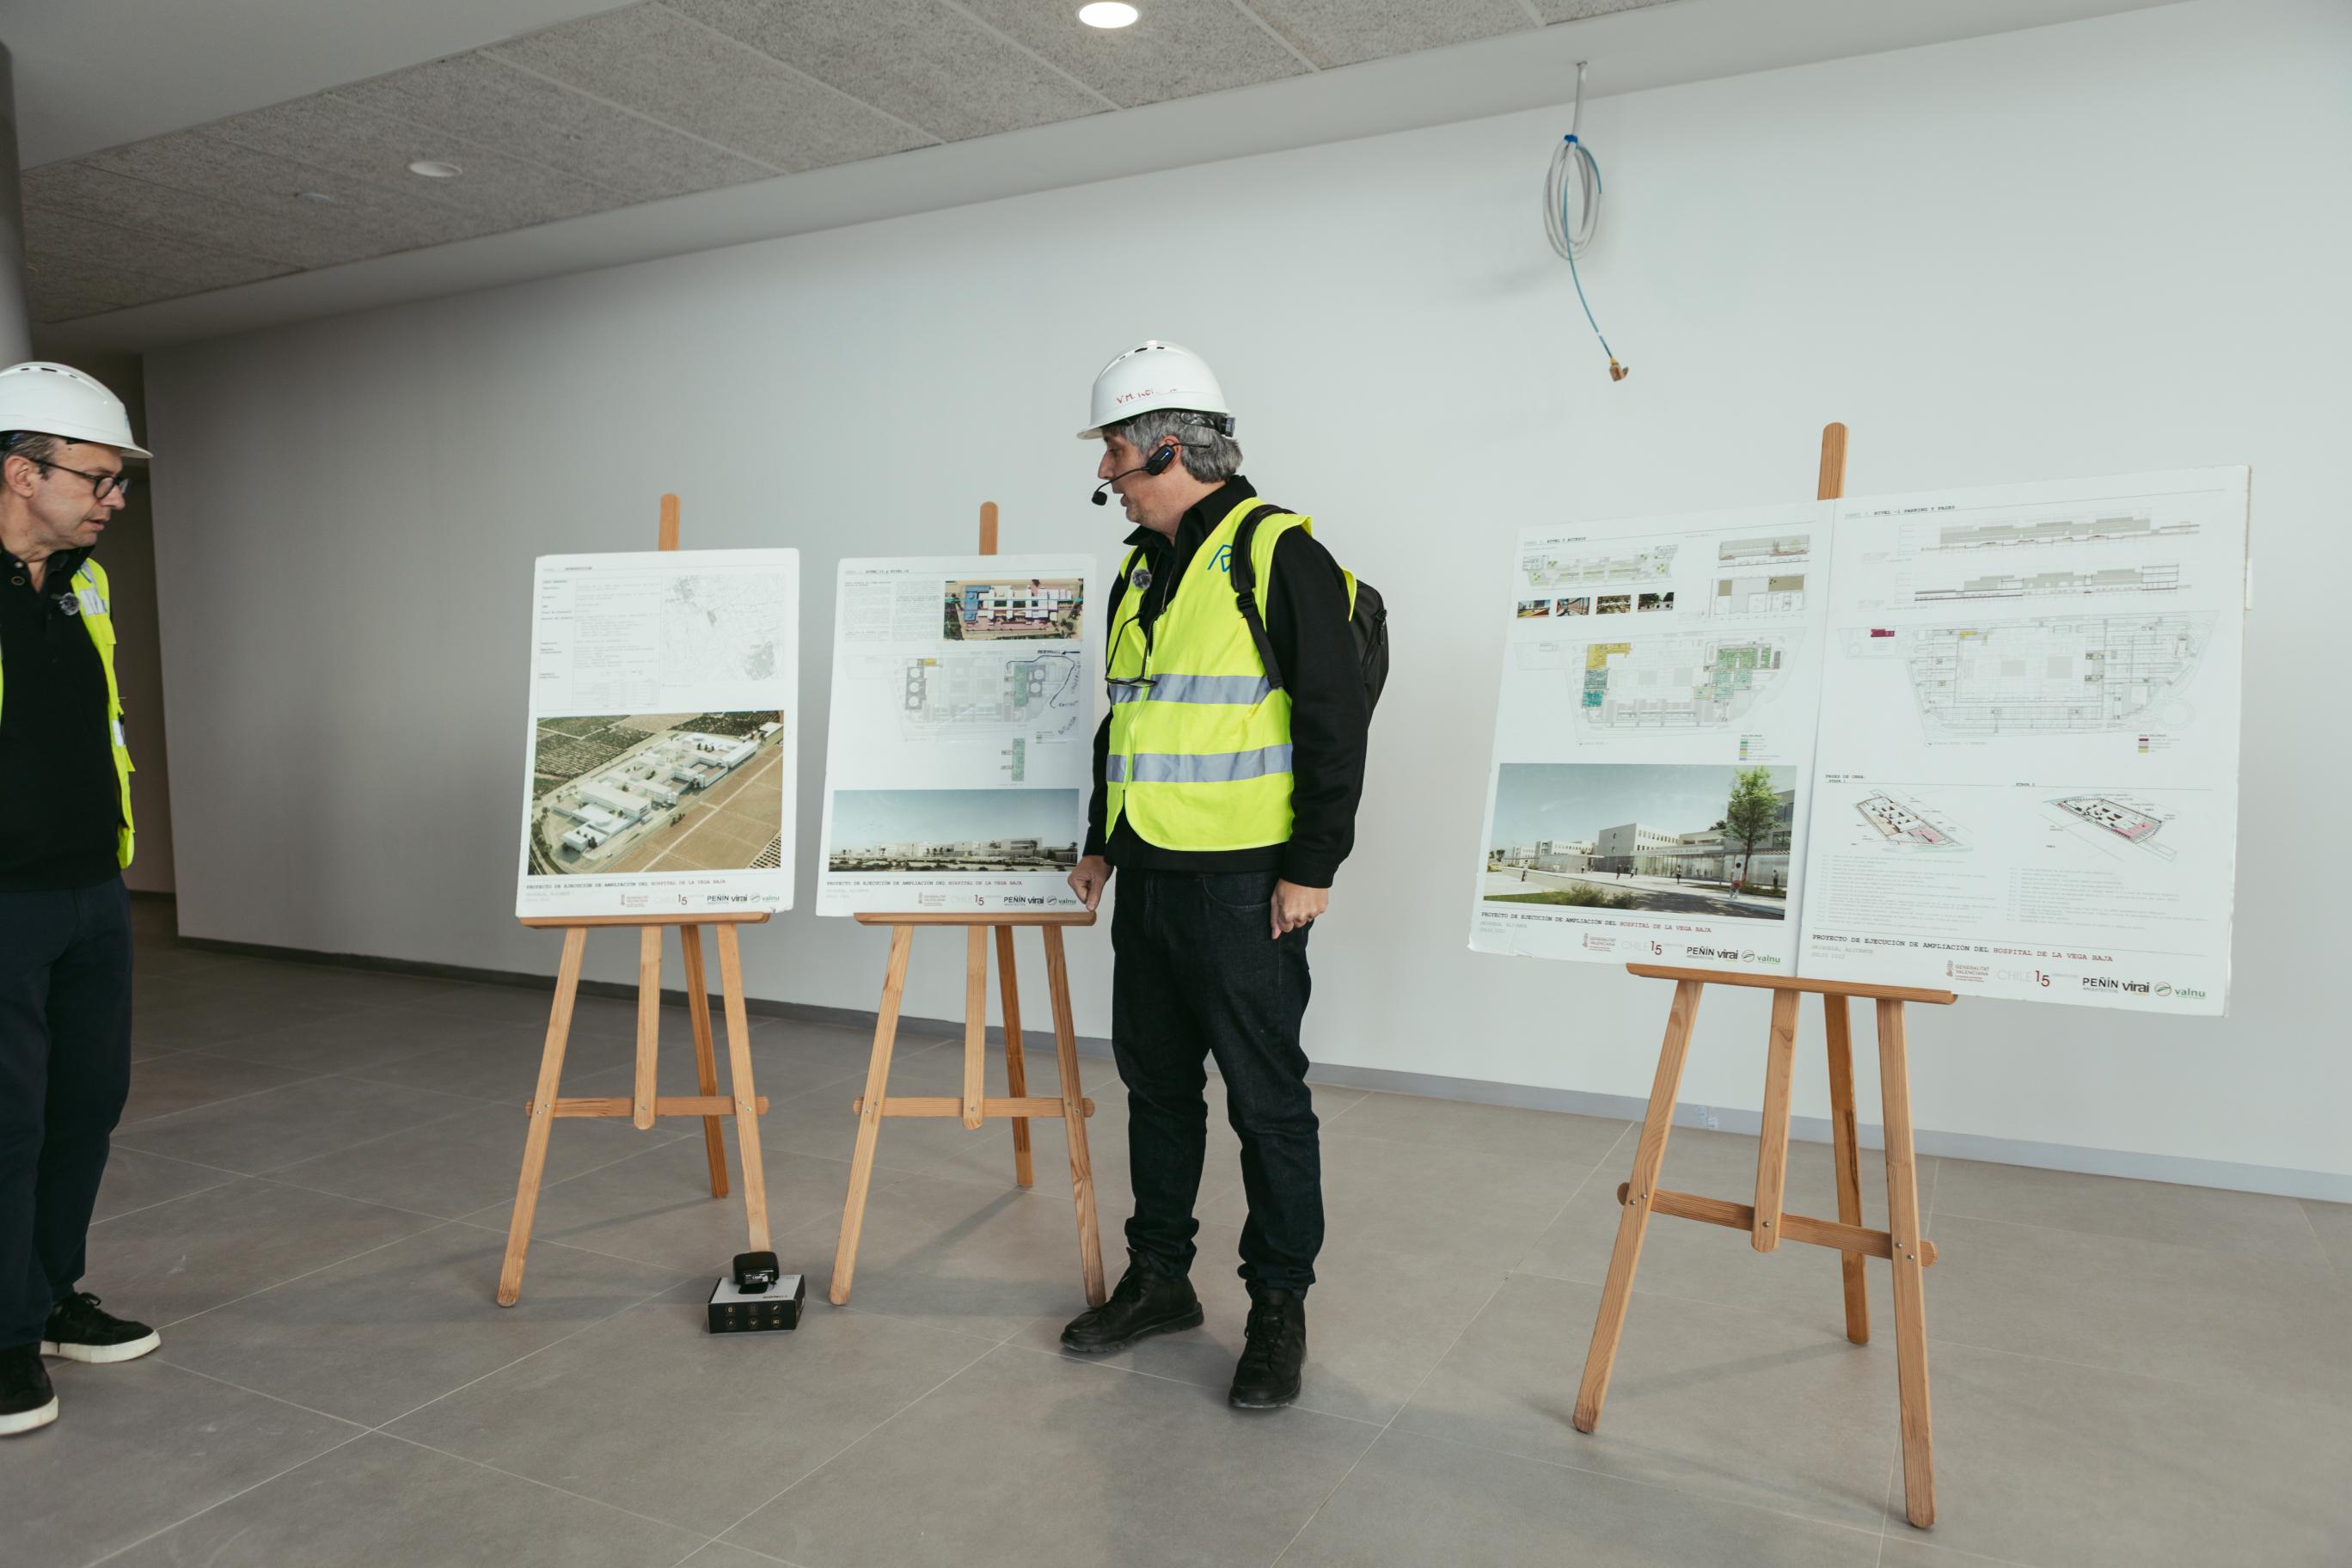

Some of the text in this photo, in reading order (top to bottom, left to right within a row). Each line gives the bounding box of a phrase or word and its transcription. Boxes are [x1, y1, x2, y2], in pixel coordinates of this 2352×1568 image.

[1027, 896, 1044, 904] virai
[1865, 938, 1905, 946] EJECUCIÓN
[1922, 942, 1970, 952] AMPLIACIÓN
[1993, 947, 2033, 956] HOSPITAL
[1717, 949, 1739, 960] virai
[1757, 954, 1780, 963] valnu
[2035, 970, 2050, 988] 15
[2122, 981, 2150, 993] virai
[2175, 988, 2206, 998] valnu
